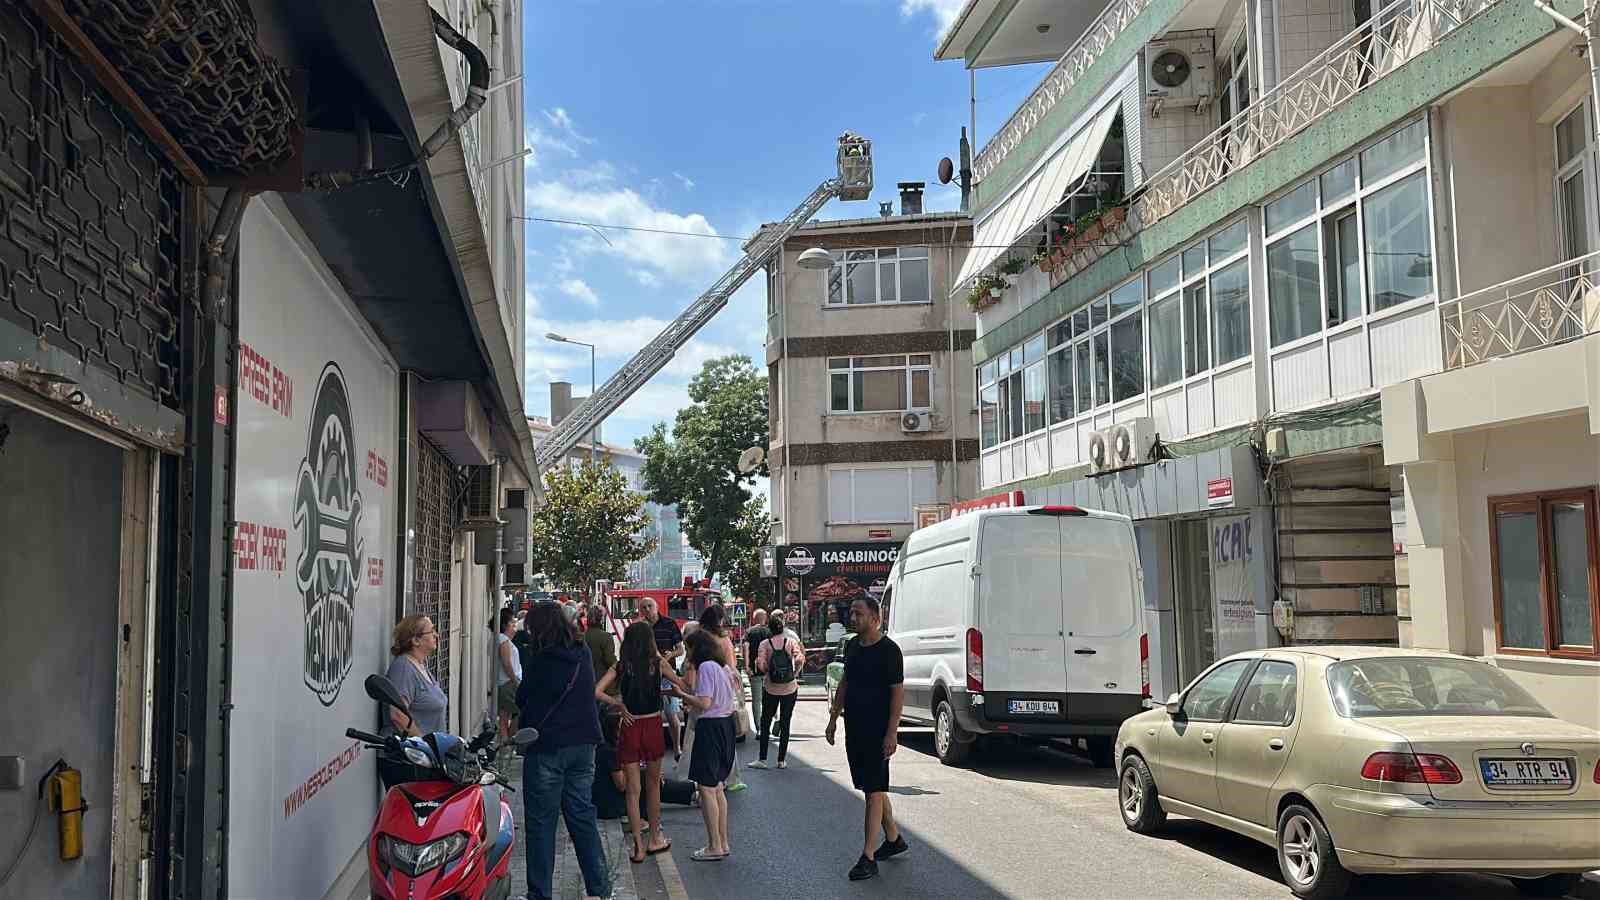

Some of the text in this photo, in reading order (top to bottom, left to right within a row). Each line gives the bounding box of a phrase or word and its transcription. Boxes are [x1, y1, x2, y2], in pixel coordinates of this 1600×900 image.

[1012, 702, 1023, 711] 34
[1489, 762, 1568, 778] 34 RTR 94
